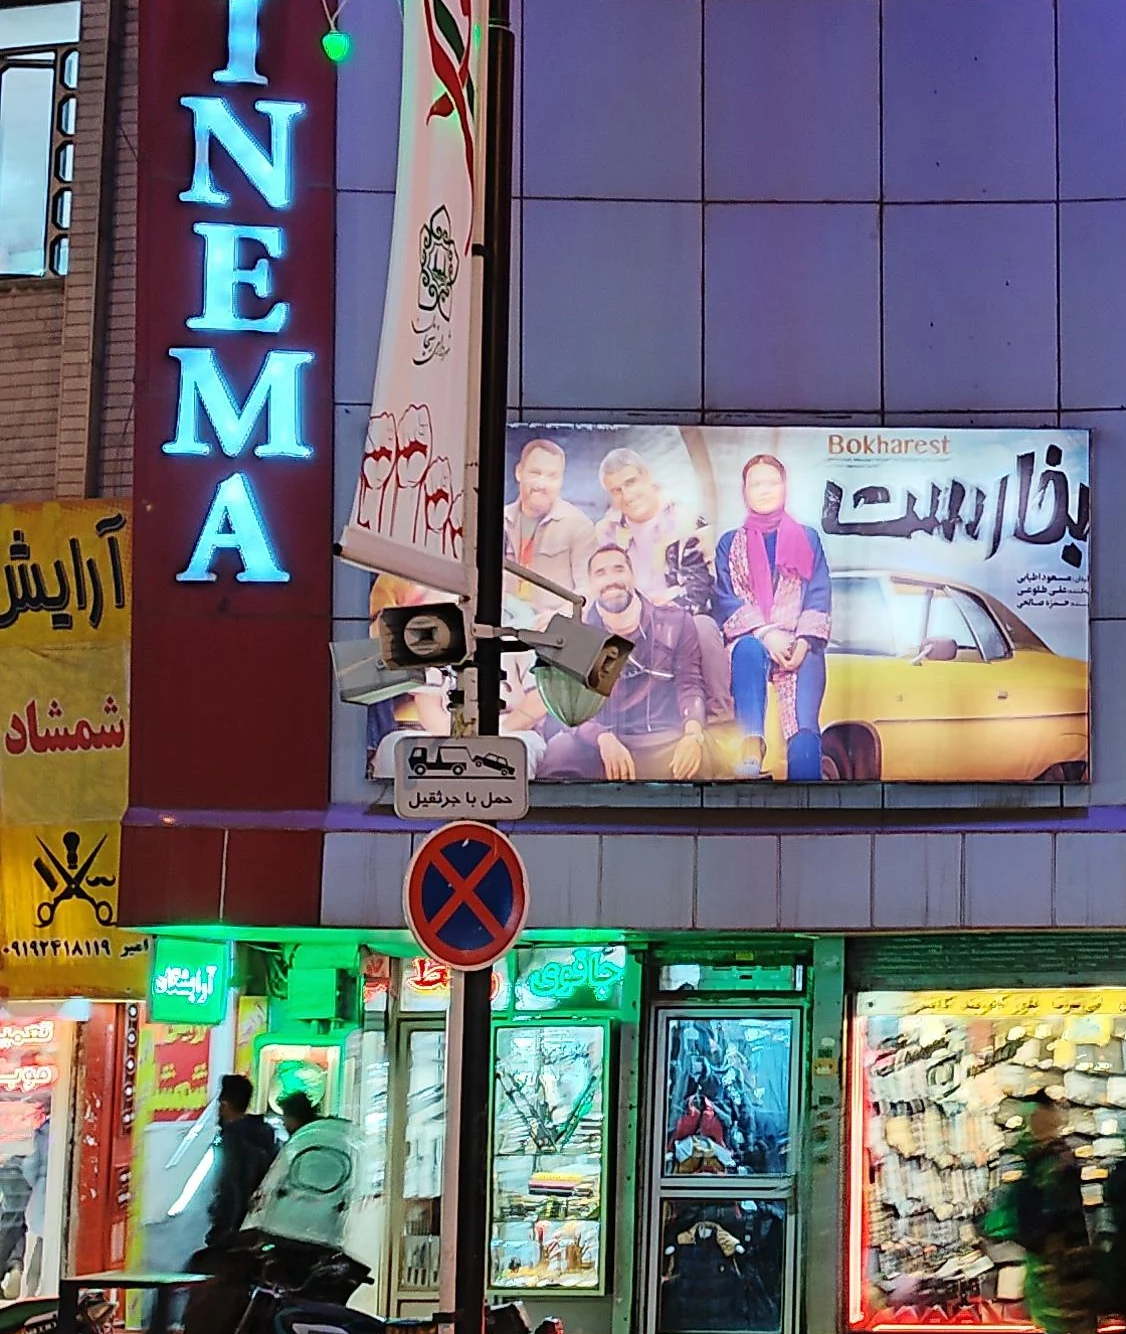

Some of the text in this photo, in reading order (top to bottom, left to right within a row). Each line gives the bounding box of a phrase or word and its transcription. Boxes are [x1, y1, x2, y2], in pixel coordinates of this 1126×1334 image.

[827, 434, 950, 455] Bokharest
[821, 443, 1090, 568] بخارست
[5, 695, 126, 756] شمشاد
[408, 789, 513, 809] حمل با جرثقیل
